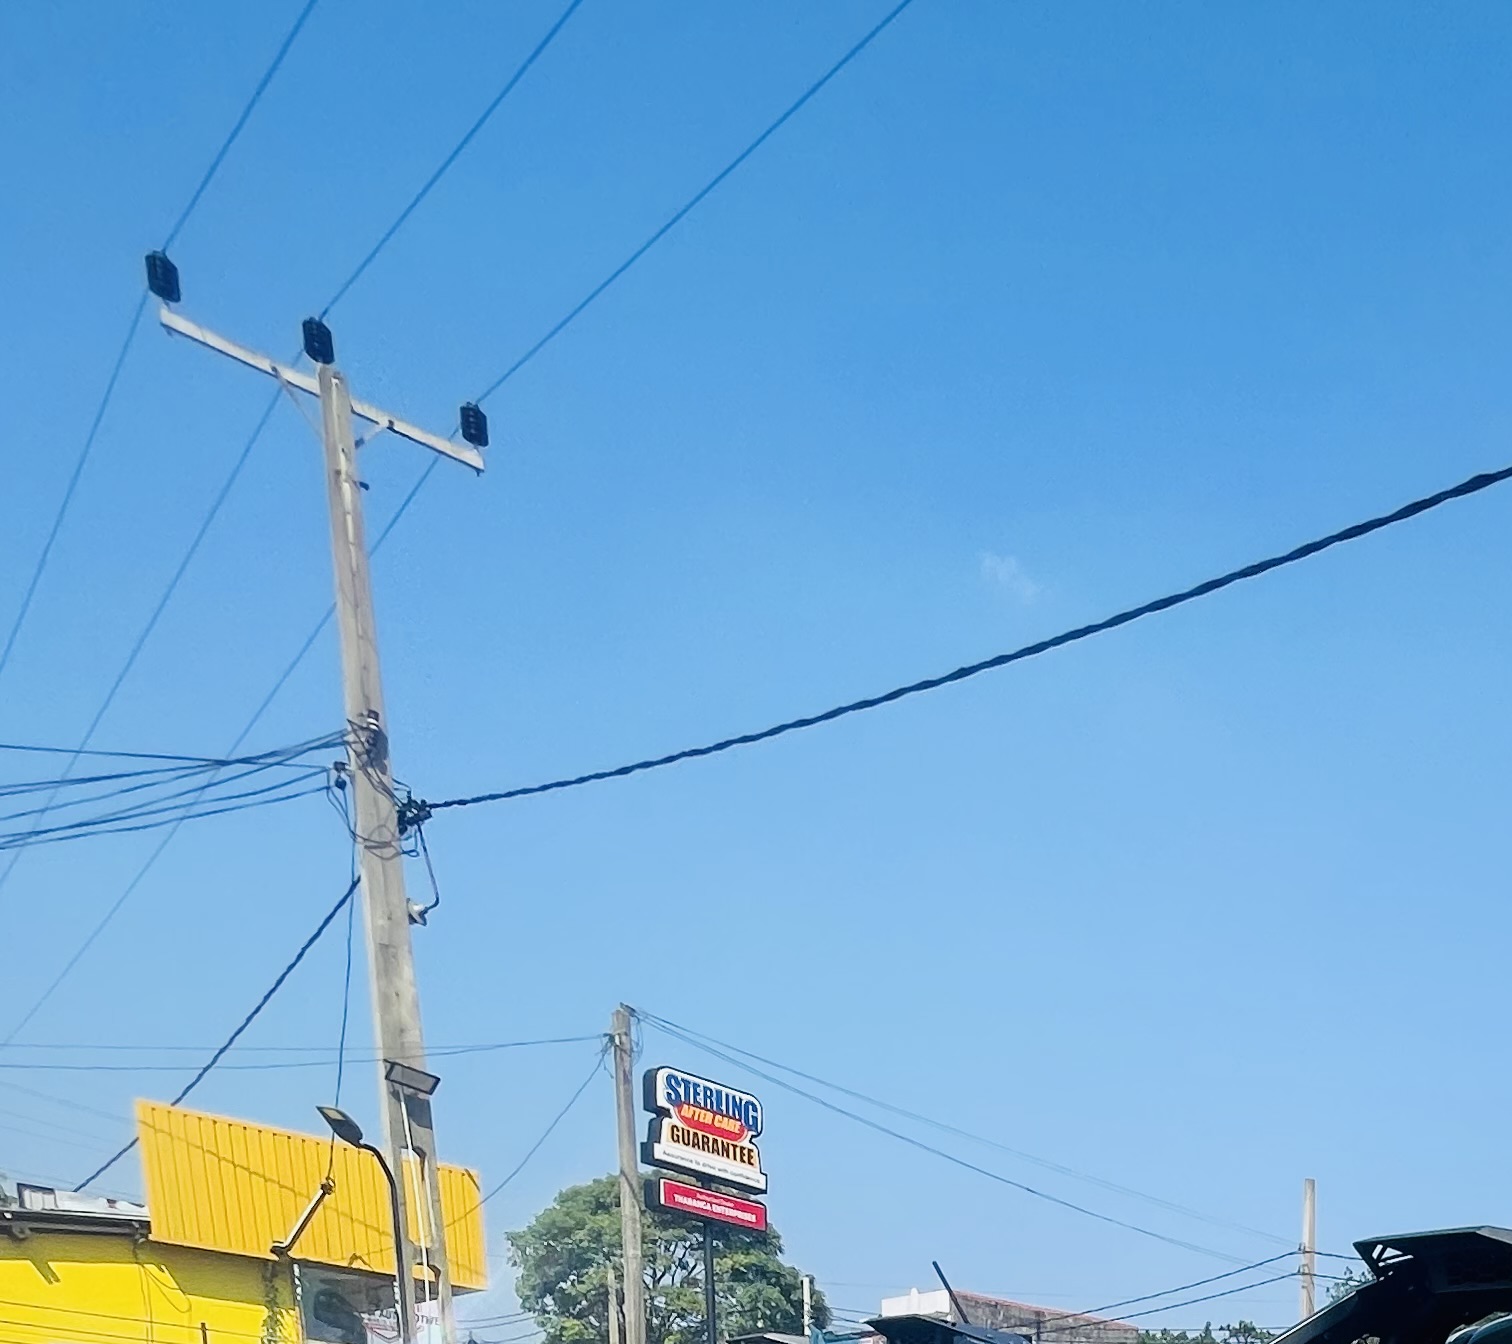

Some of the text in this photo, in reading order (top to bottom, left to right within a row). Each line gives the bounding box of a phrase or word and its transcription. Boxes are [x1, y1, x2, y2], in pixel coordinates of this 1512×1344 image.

[665, 1073, 759, 1132] STERLING
[680, 1104, 742, 1134] AFTER CARE
[671, 1125, 755, 1166] GUARANTEE
